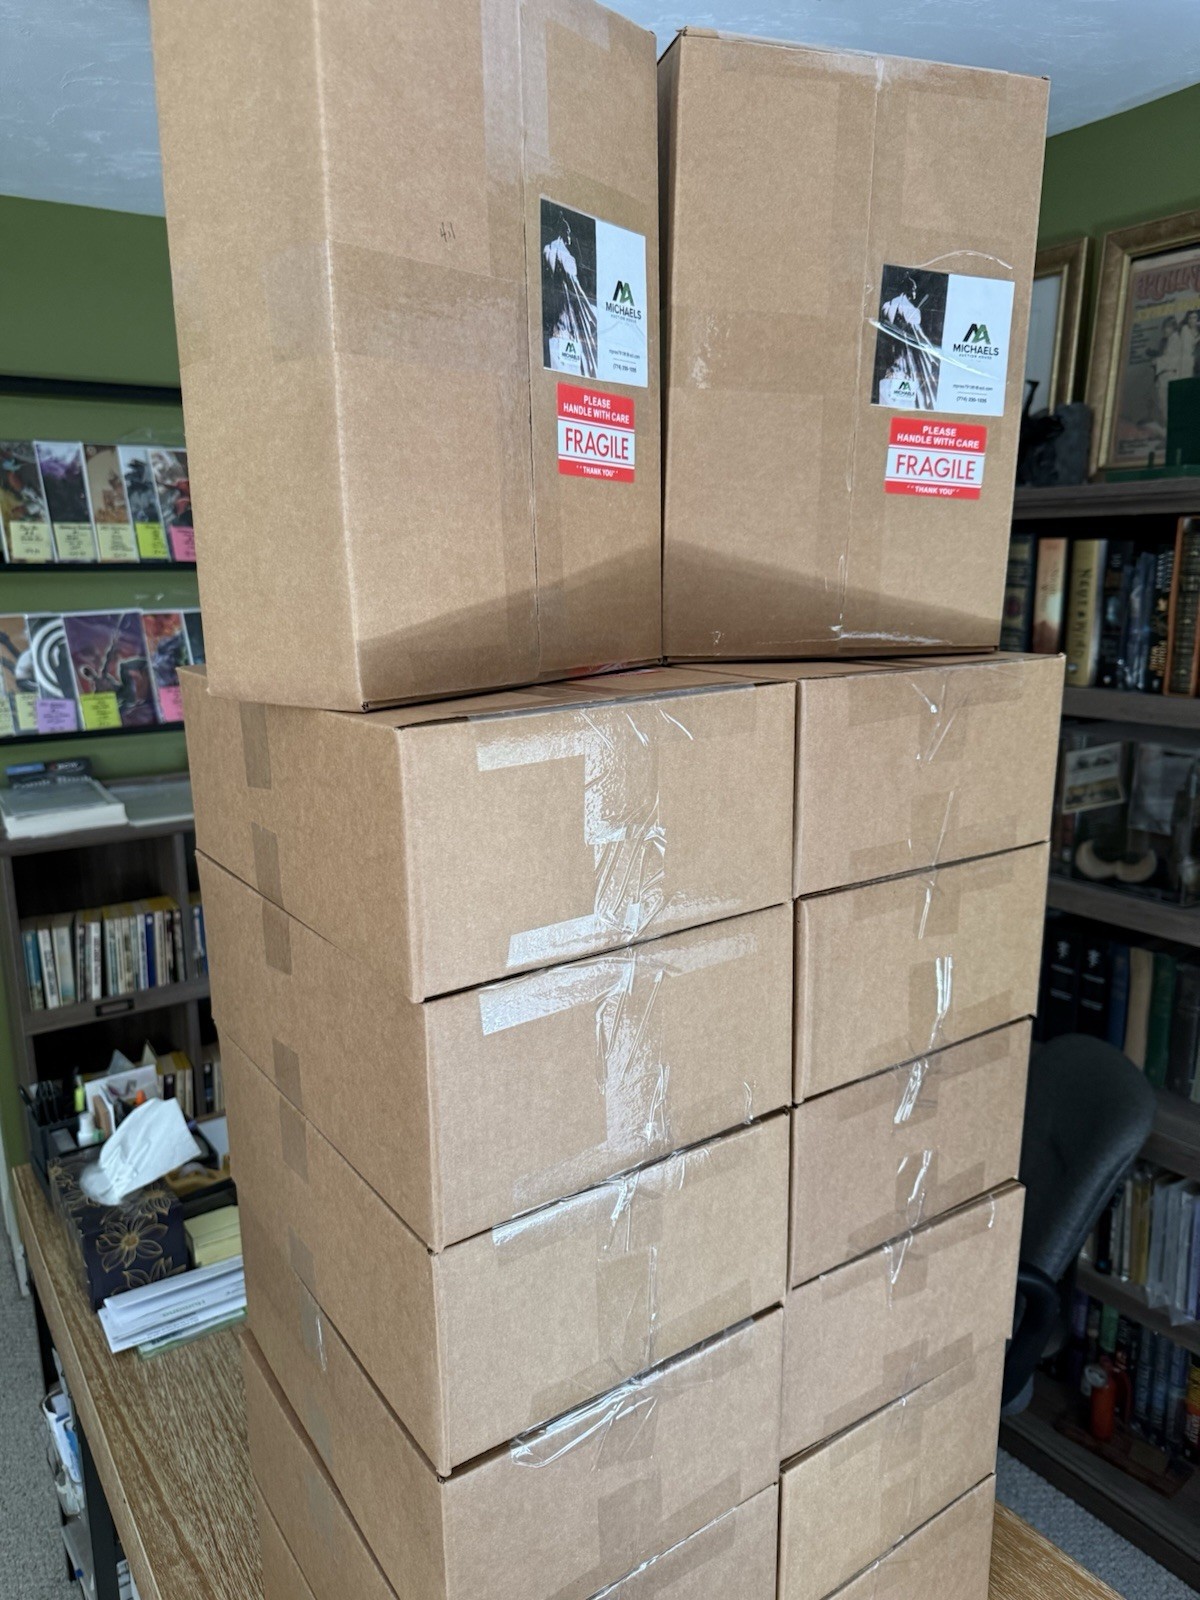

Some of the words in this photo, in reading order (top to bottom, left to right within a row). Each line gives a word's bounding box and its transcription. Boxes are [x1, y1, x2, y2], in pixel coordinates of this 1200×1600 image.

[605, 302, 642, 320] MICHAELS
[953, 343, 999, 356] MICHAELS
[583, 394, 611, 409] PLEASE
[563, 402, 592, 417] HANDLE
[593, 409, 611, 421] WITH
[611, 412, 630, 425] CARE
[922, 425, 957, 437] PLEASE
[565, 427, 629, 460] FRAGILE
[896, 433, 933, 445] HANDLE
[933, 436, 955, 447] WITH
[956, 438, 980, 449] CARE
[896, 454, 976, 480] FRAGILE
